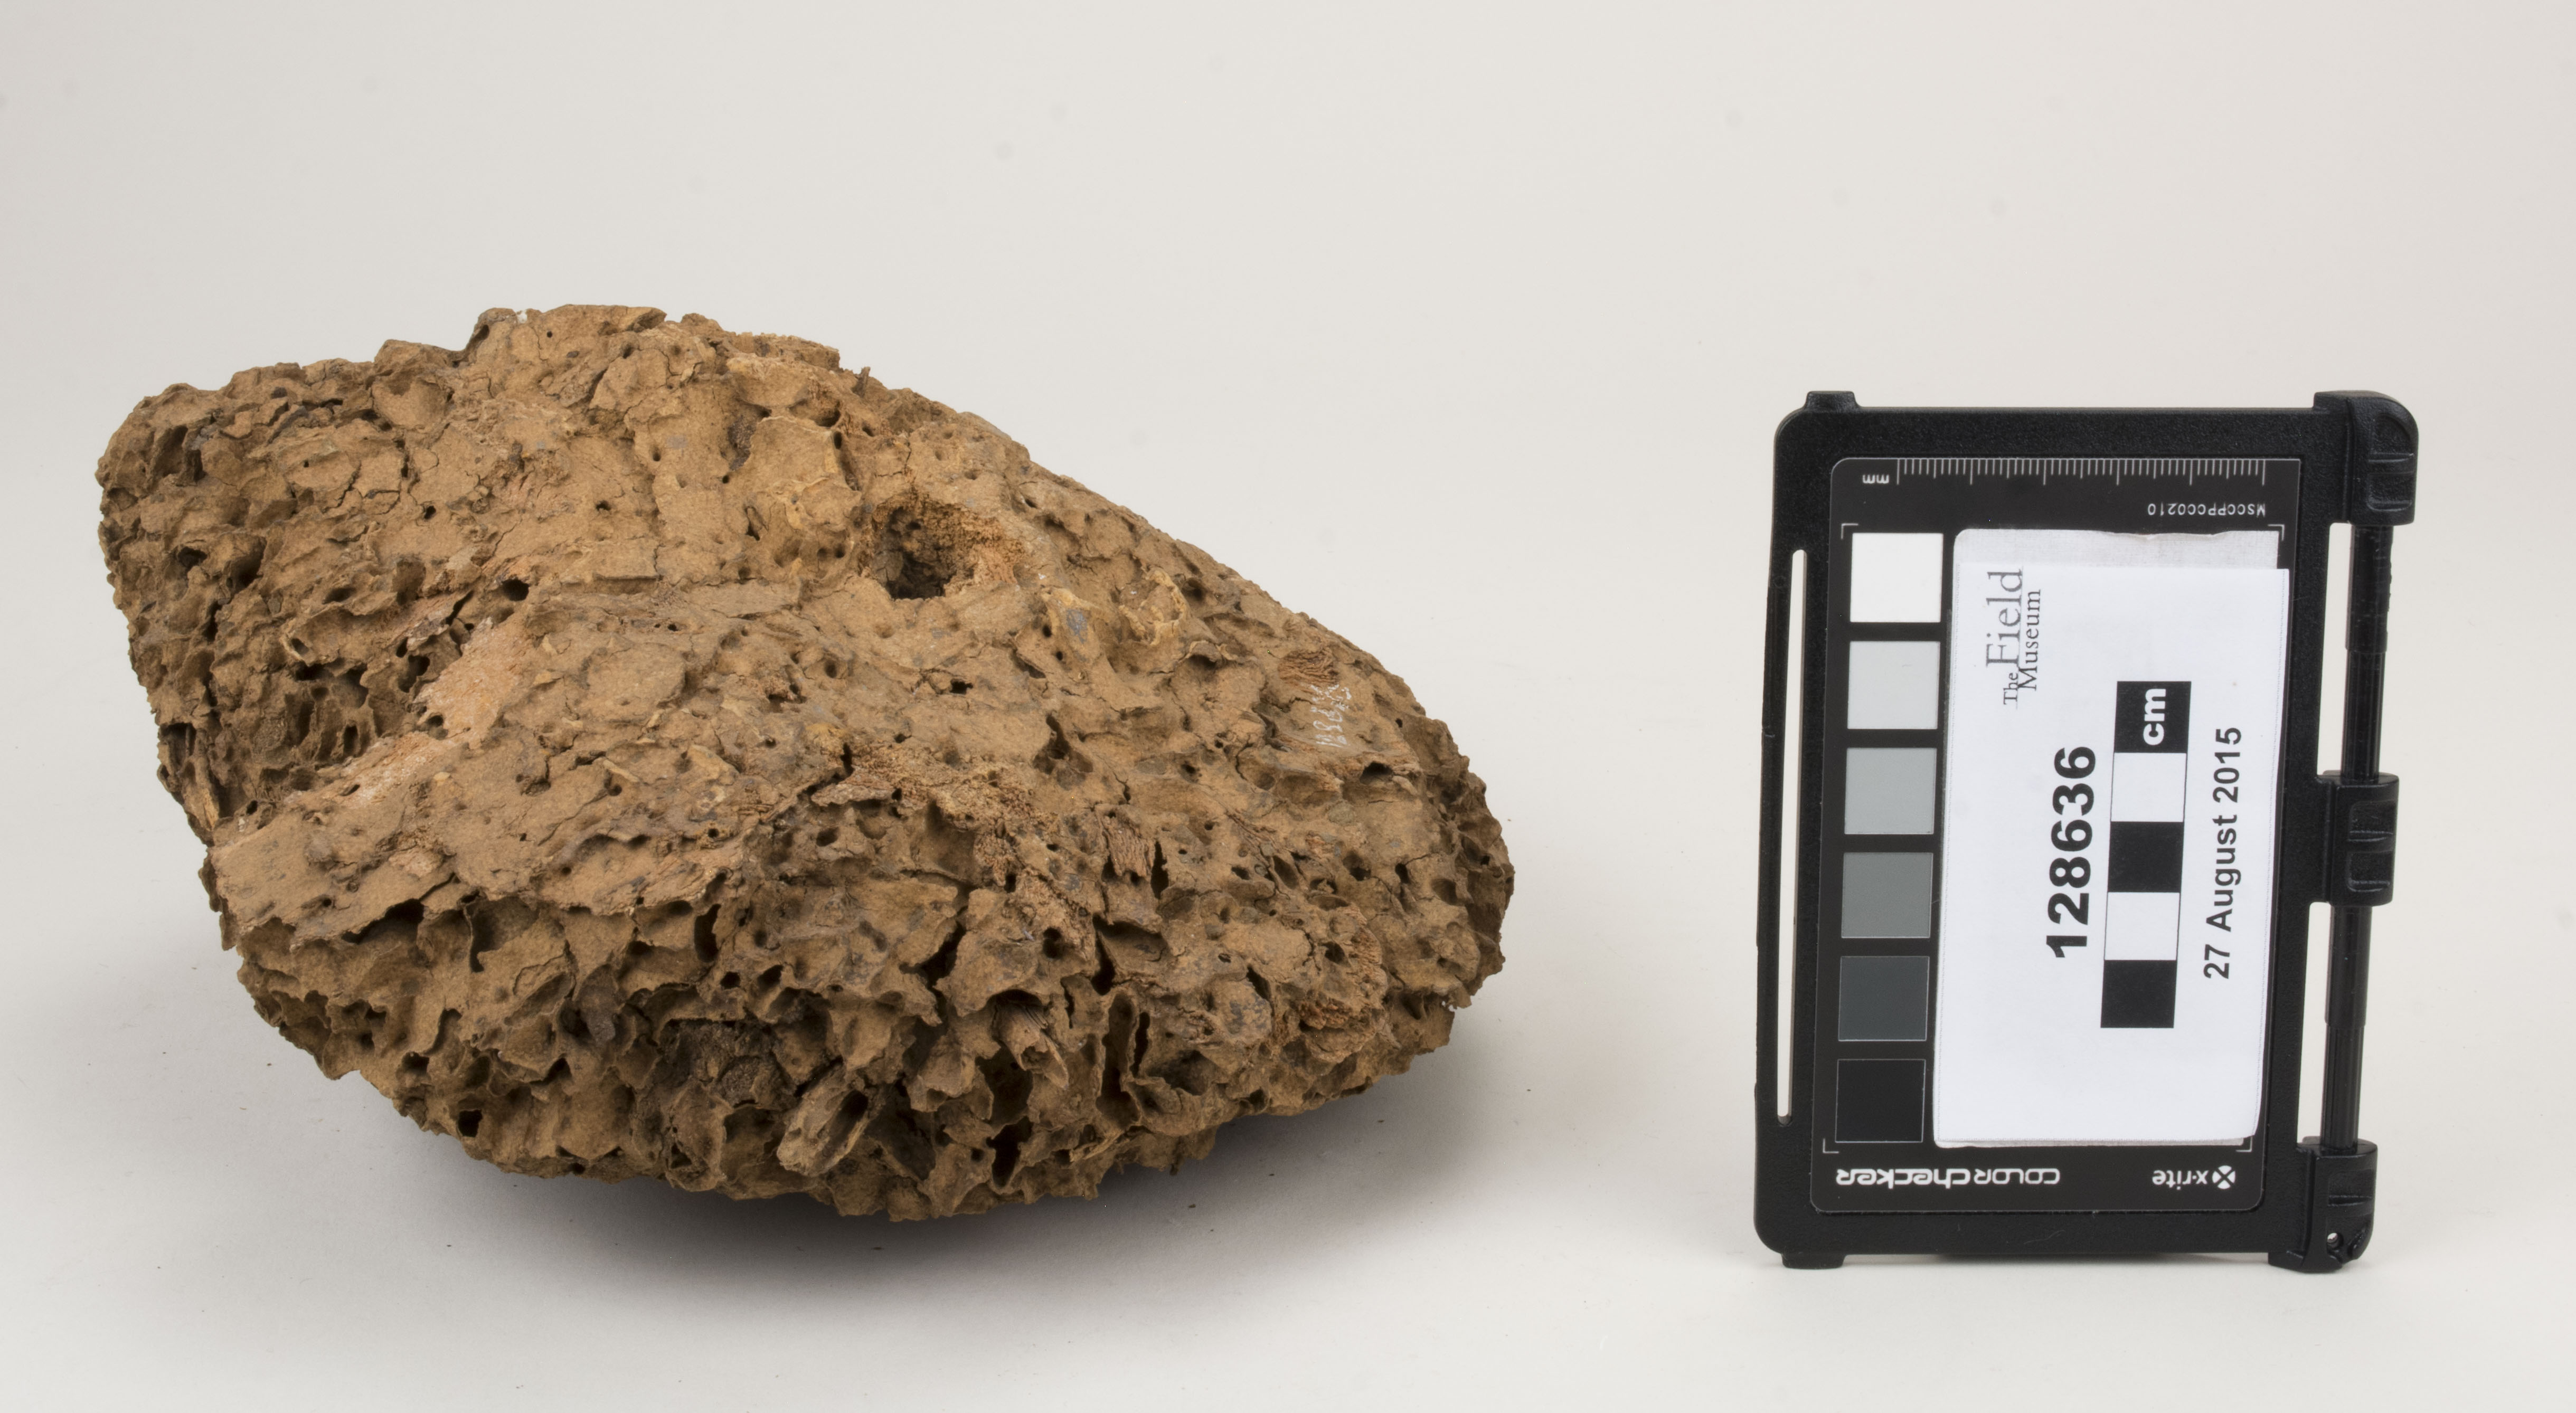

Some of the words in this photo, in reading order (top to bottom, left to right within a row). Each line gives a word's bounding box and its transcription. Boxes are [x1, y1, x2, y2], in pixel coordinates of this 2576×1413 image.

[1862, 474, 1890, 484] mm
[1986, 569, 2022, 668] Field
[2017, 589, 2041, 691] Museum
[2003, 672, 2018, 705] The
[2143, 688, 2166, 745] cm
[2212, 727, 2242, 803] 2015
[2046, 746, 2096, 958] 128636
[2205, 814, 2242, 932] August
[2203, 944, 2231, 979] 27
